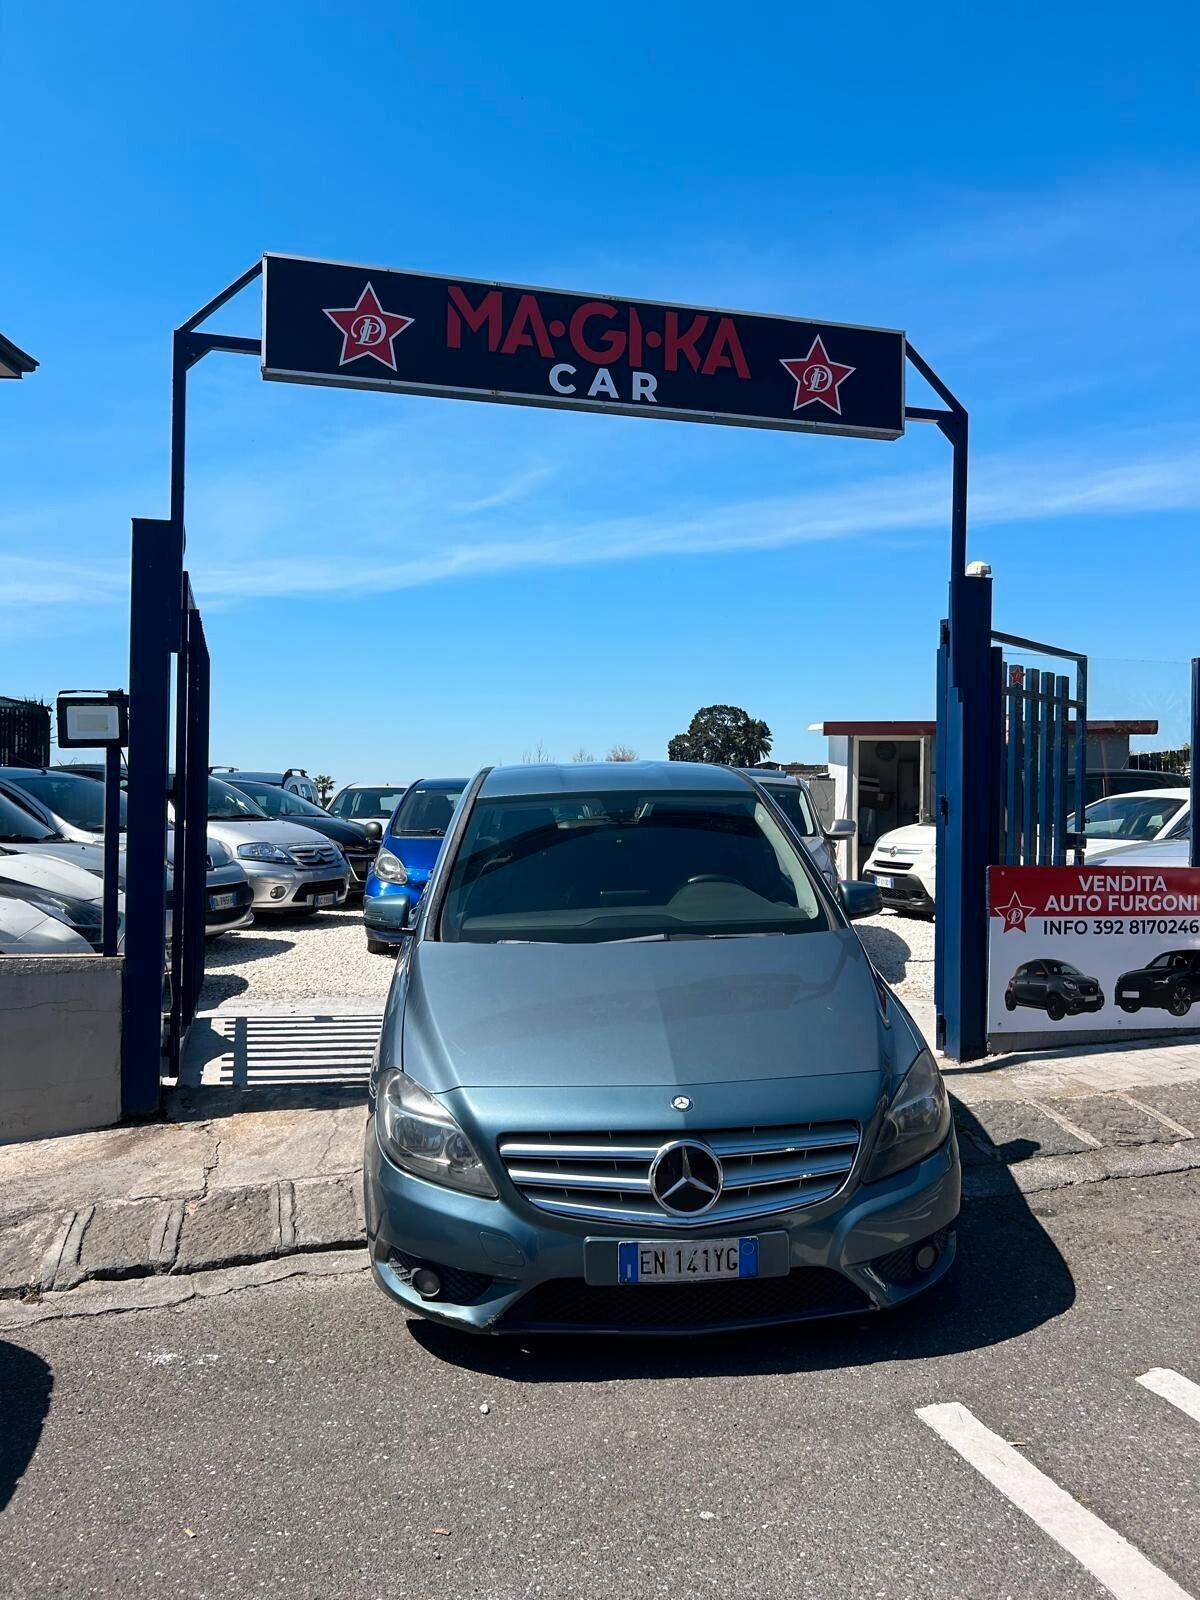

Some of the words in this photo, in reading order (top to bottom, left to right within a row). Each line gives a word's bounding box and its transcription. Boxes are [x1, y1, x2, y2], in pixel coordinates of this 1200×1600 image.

[549, 363, 658, 402] CAR
[1079, 875, 1168, 892] VENDITA
[1044, 895, 1102, 912] AUTO
[1108, 894, 1198, 912] FURGONI
[1043, 920, 1088, 935] INFO
[1093, 919, 1124, 935] 392
[1129, 919, 1200, 935] 8170246
[640, 1250, 666, 1275] EN
[675, 1248, 738, 1273] 141YG
